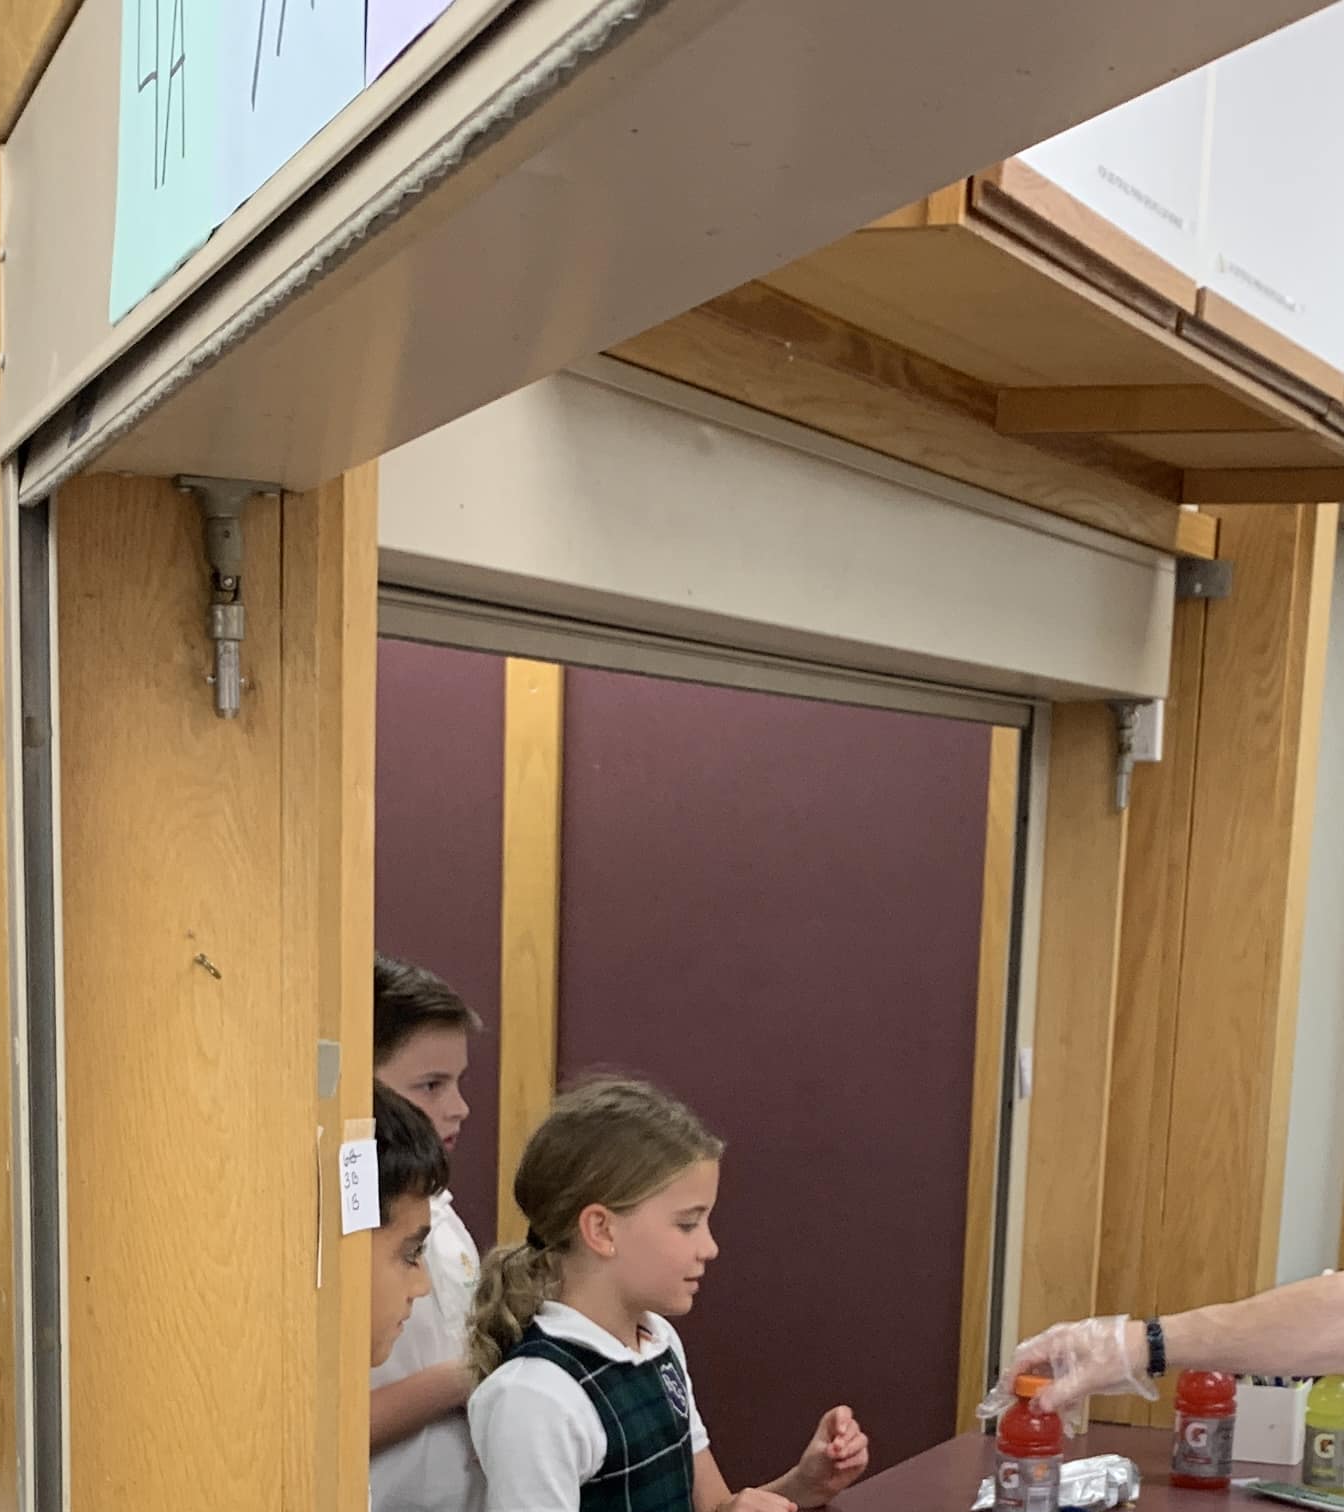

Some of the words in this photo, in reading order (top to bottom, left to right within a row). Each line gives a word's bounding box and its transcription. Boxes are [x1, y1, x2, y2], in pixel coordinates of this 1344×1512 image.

[1184, 1421, 1209, 1448] G
[1313, 1433, 1336, 1459] G
[998, 1461, 1020, 1489] G
